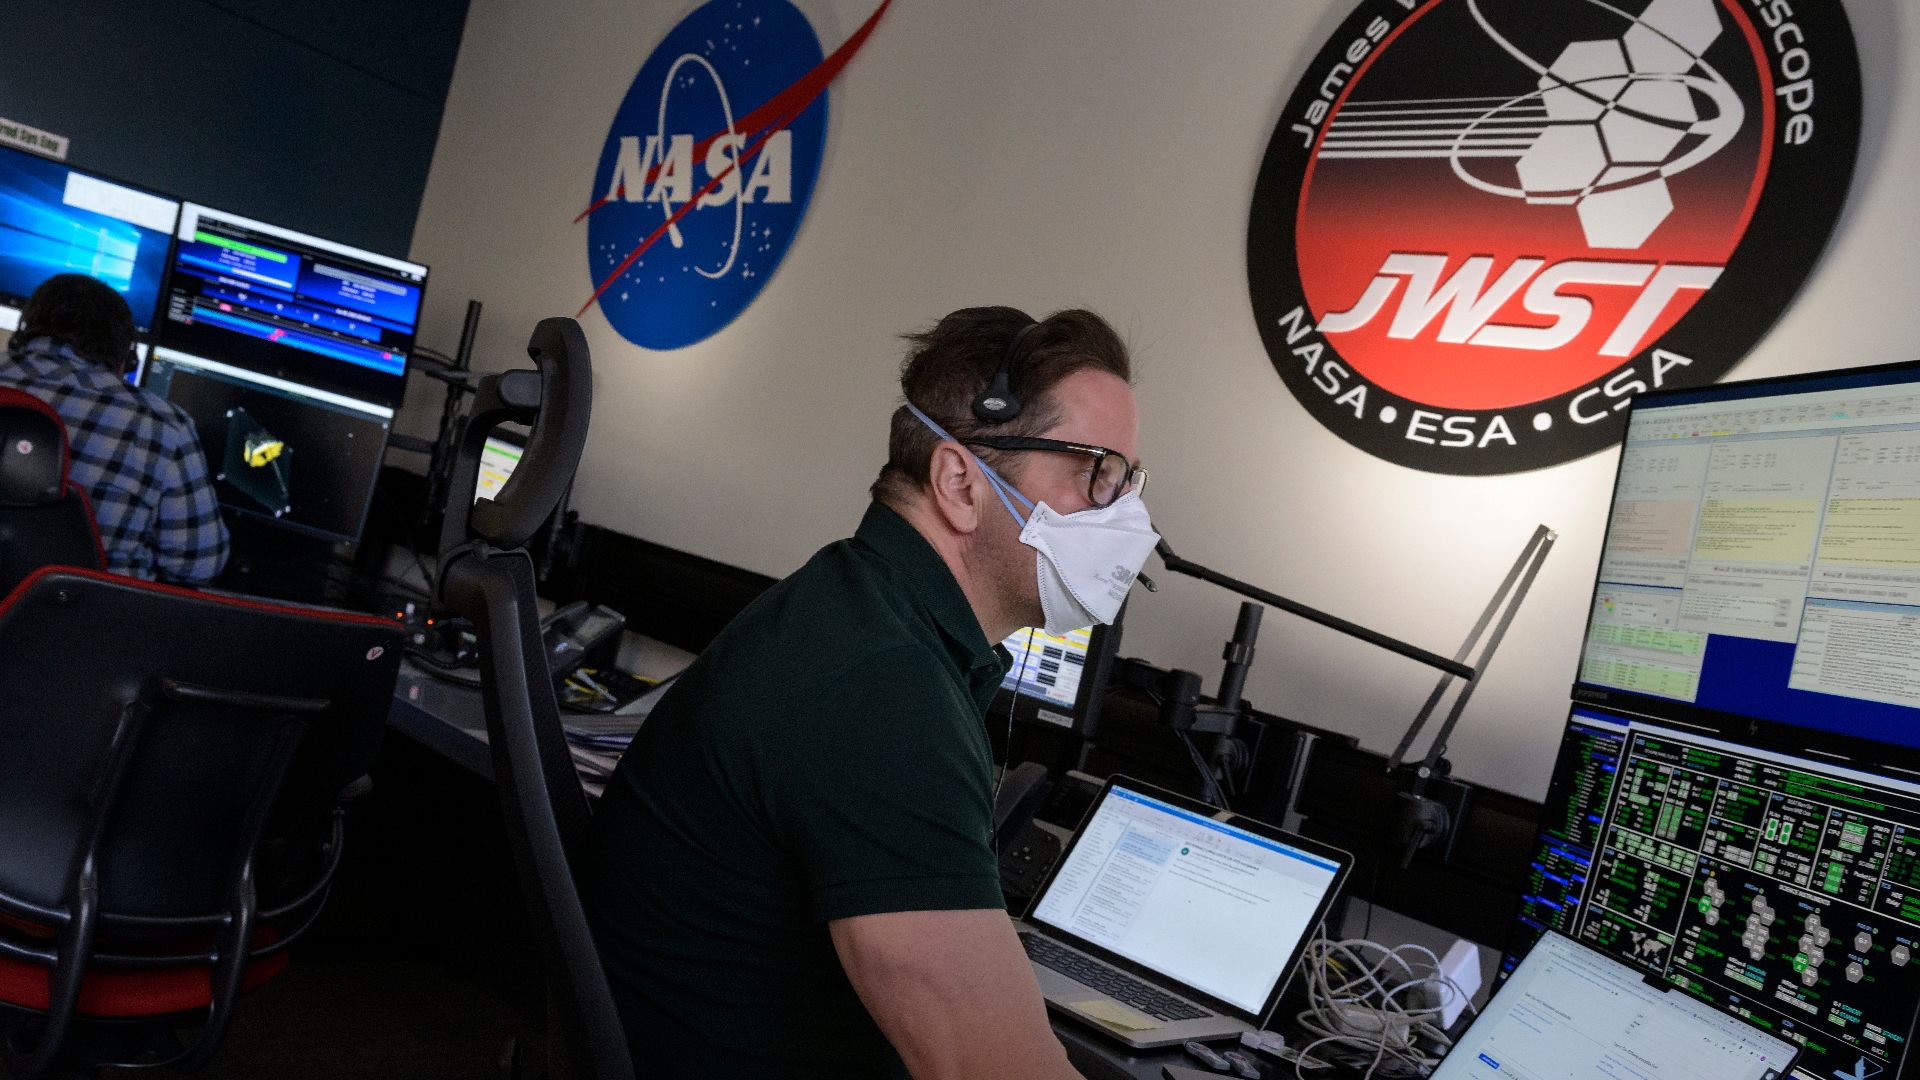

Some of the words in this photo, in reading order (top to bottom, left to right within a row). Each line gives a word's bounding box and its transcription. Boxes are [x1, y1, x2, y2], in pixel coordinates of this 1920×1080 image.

[1291, 15, 1391, 149] James
[1751, 0, 1815, 145] scope
[606, 130, 793, 211] NASA
[1316, 250, 1726, 358] JWST
[1277, 306, 1369, 420] NASA
[1405, 410, 1517, 449] ESA
[1568, 347, 1693, 425] CSA
